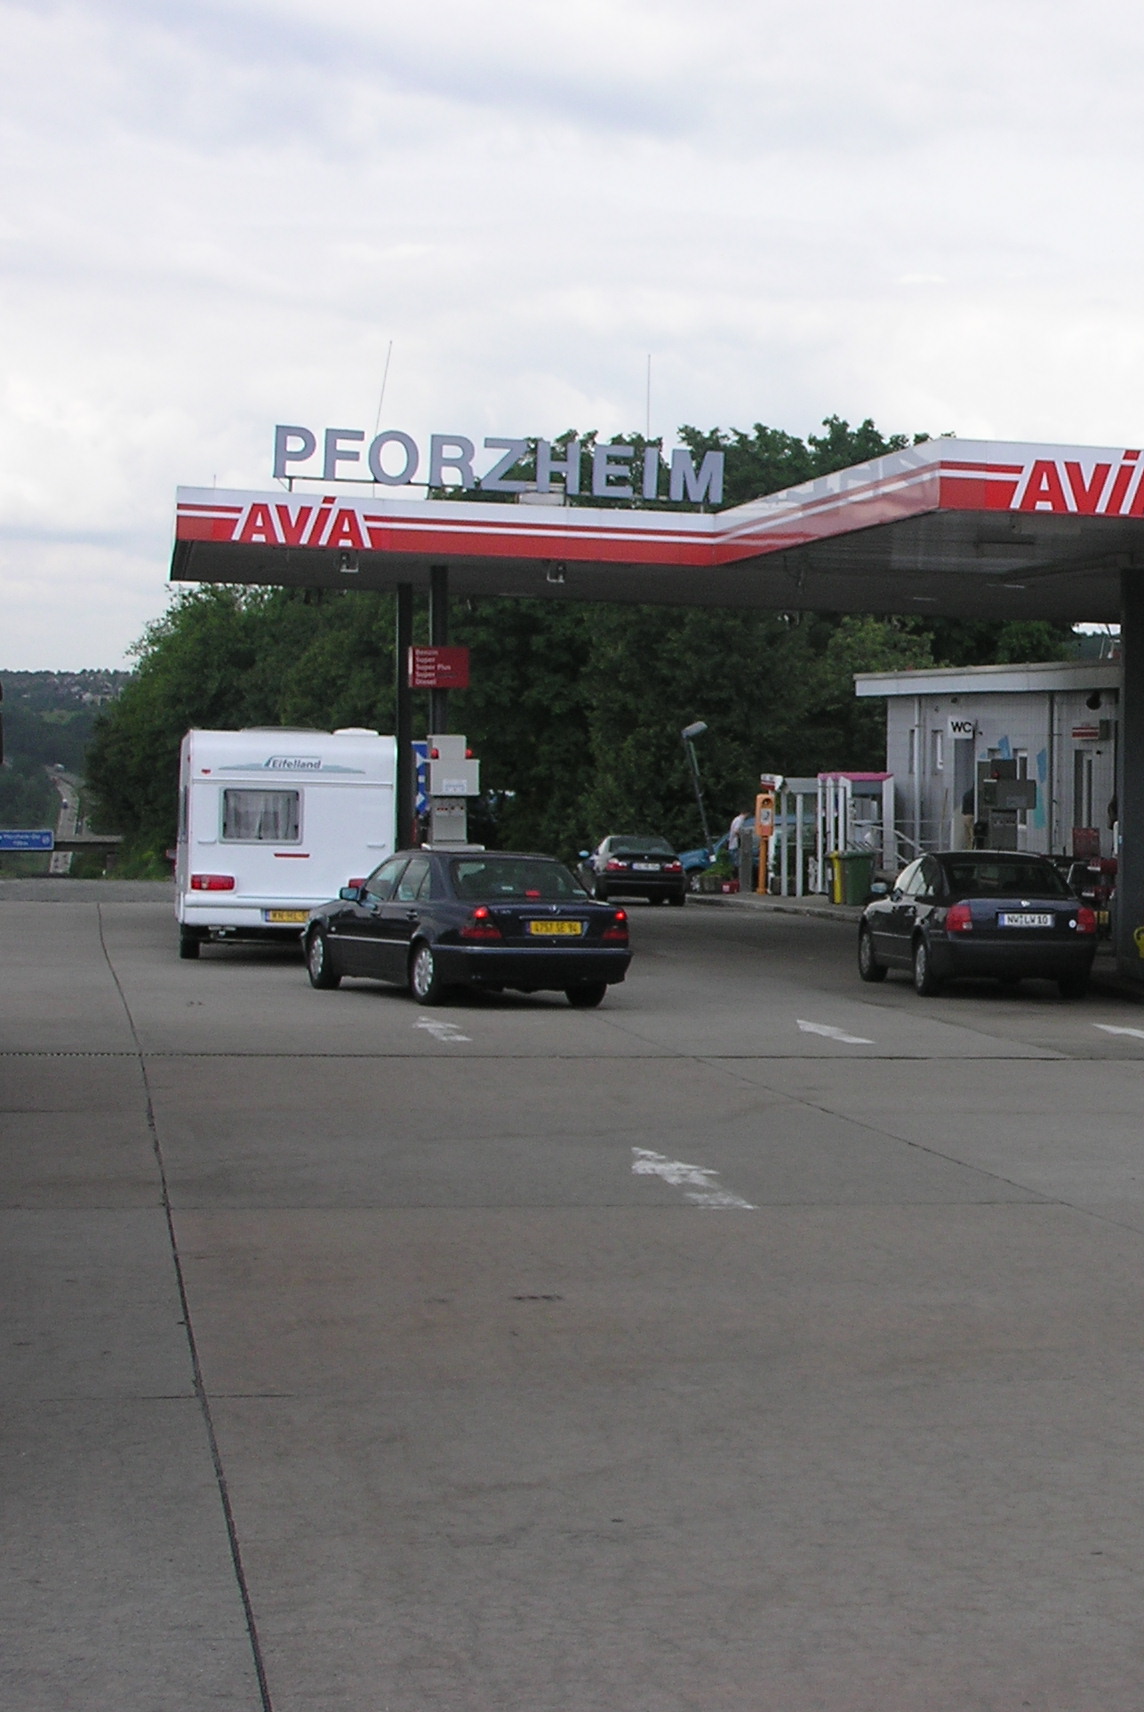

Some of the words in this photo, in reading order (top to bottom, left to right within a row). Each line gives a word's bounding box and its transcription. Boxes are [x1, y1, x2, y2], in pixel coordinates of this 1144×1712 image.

[273, 425, 725, 504] PFORZHEIM
[237, 496, 364, 547] AVIA
[951, 721, 972, 733] WC
[272, 759, 321, 769] Eifelland
